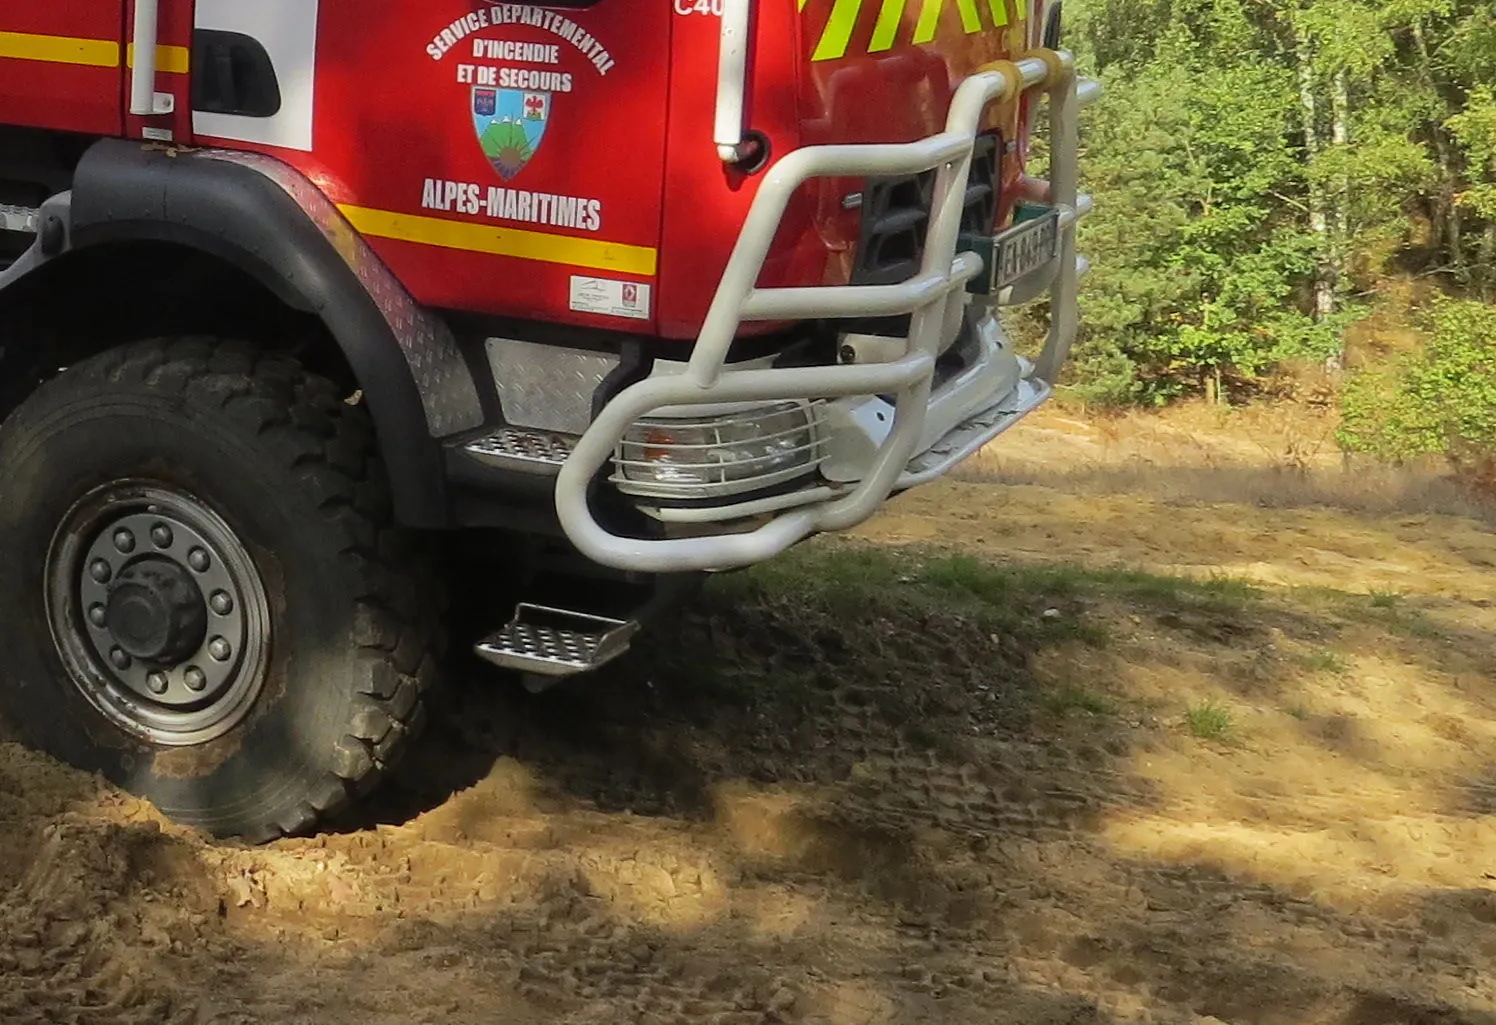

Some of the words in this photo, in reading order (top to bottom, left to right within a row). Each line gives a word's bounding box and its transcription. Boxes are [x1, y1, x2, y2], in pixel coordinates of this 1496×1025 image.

[426, 8, 489, 61] SERVICE
[490, 5, 616, 76] DEPARTEMENTAL
[472, 38, 560, 64] D'INCENDIE
[456, 63, 475, 83] ET
[477, 65, 497, 85] DE
[498, 68, 573, 93] SECOURS
[421, 178, 601, 231] ALPES-MARITIMES
